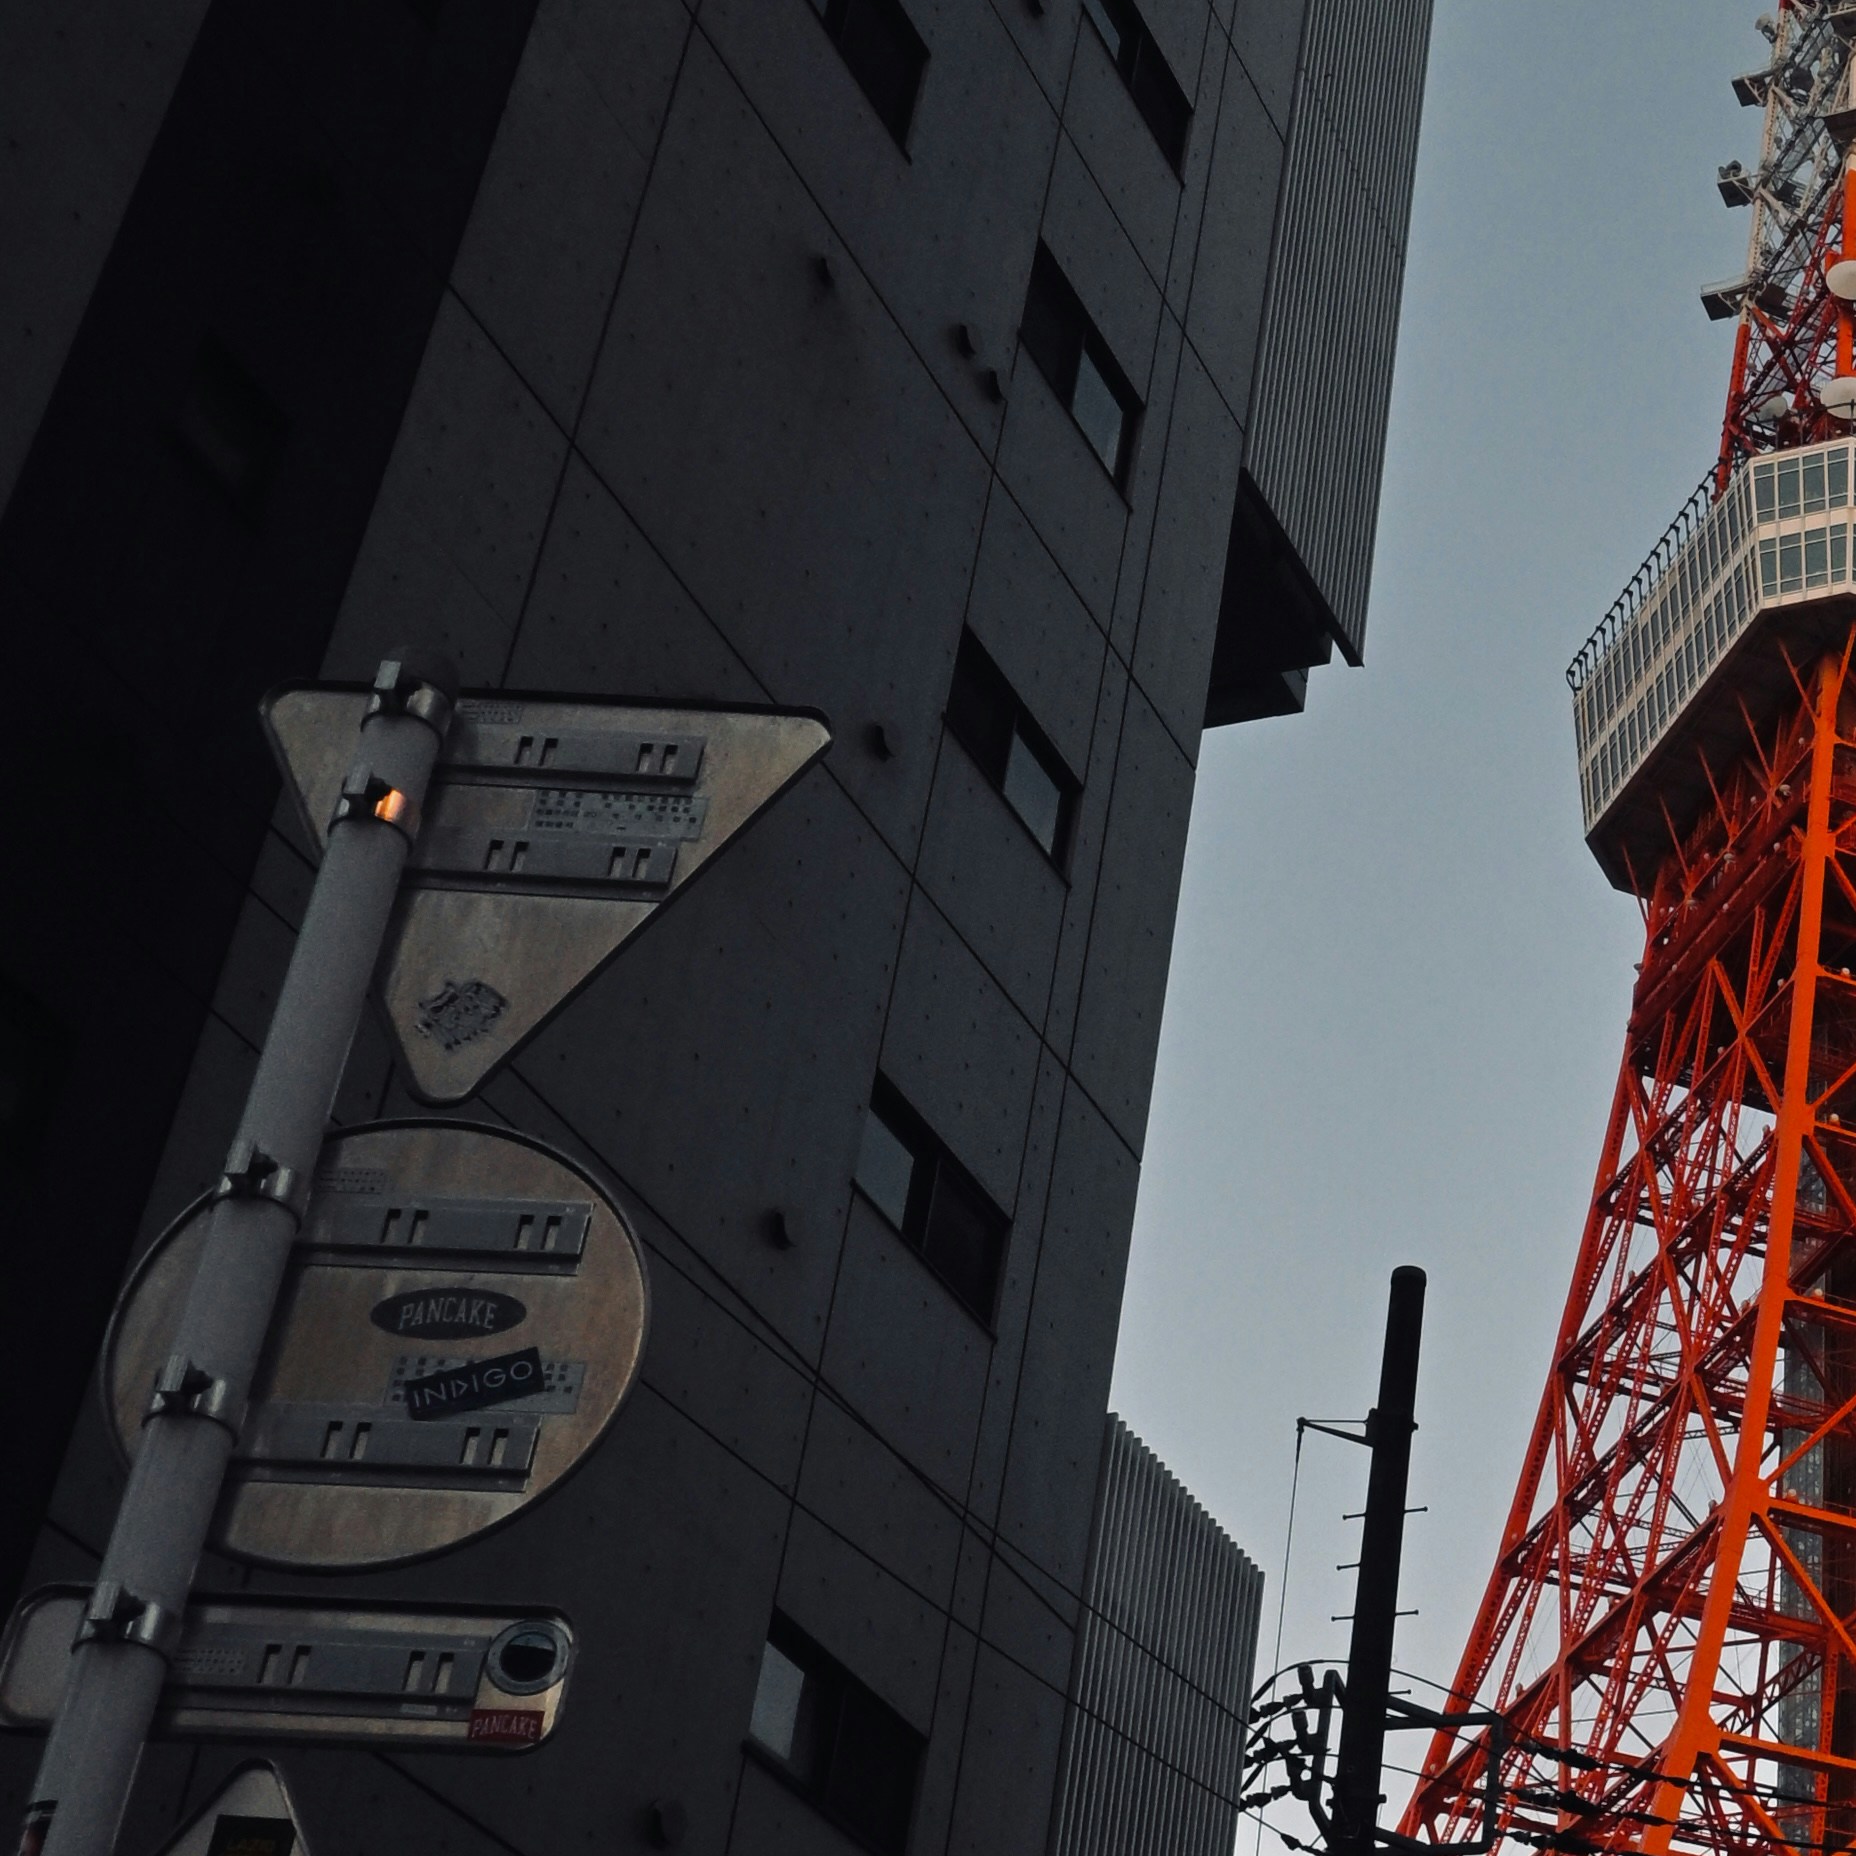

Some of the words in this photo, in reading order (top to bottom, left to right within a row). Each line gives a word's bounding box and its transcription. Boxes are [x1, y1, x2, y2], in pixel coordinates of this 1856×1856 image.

[398, 1297, 497, 1330] PANCAKE
[414, 1360, 533, 1407] INDIGO
[471, 1714, 538, 1738] PANCAKE
